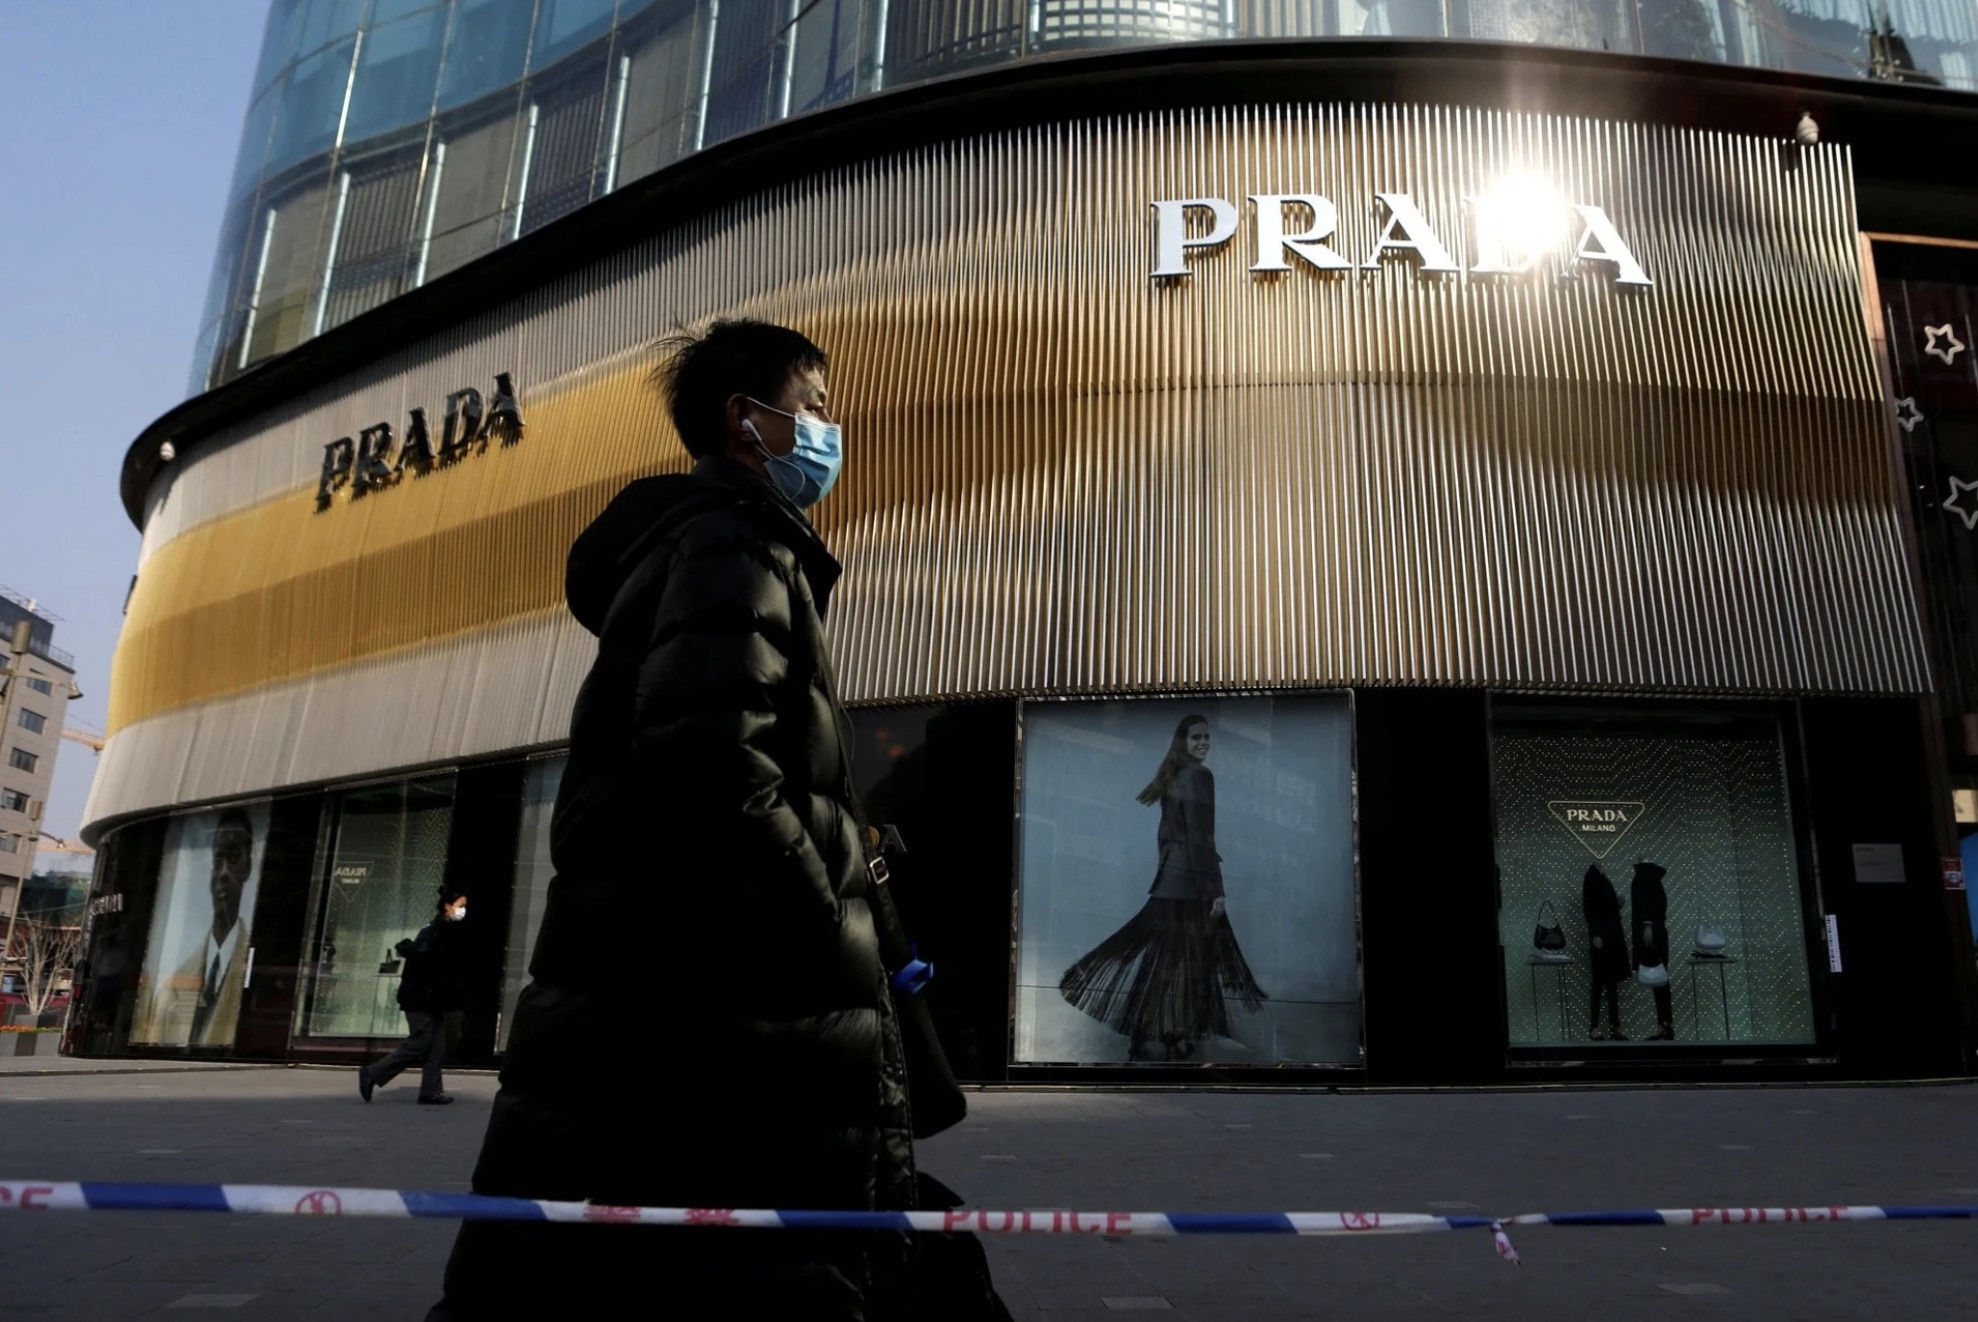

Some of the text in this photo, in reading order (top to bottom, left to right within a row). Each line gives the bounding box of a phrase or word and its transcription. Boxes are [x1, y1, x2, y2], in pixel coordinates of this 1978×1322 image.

[314, 371, 525, 504] PRADA
[1567, 810, 1627, 821] PRADA
[1581, 824, 1616, 832] MILANO
